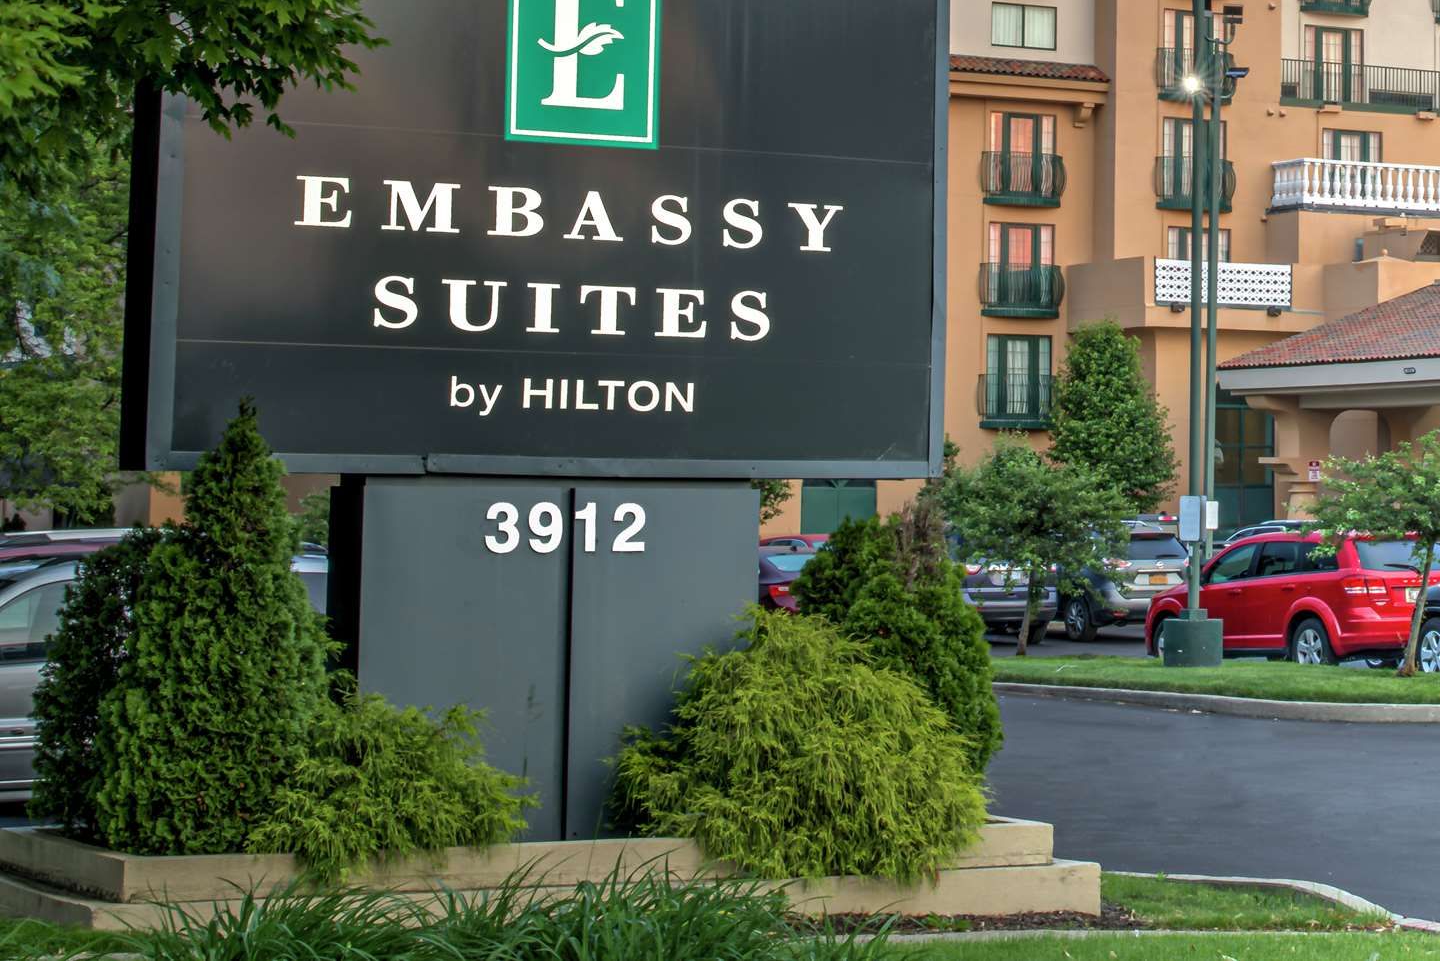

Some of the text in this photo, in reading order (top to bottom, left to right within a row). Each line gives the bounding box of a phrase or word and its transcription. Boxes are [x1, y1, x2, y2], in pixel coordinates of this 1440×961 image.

[293, 175, 844, 253] EMBASSY
[373, 275, 771, 342] SUITES
[450, 375, 695, 417] by HILTON
[484, 501, 646, 554] 3912
